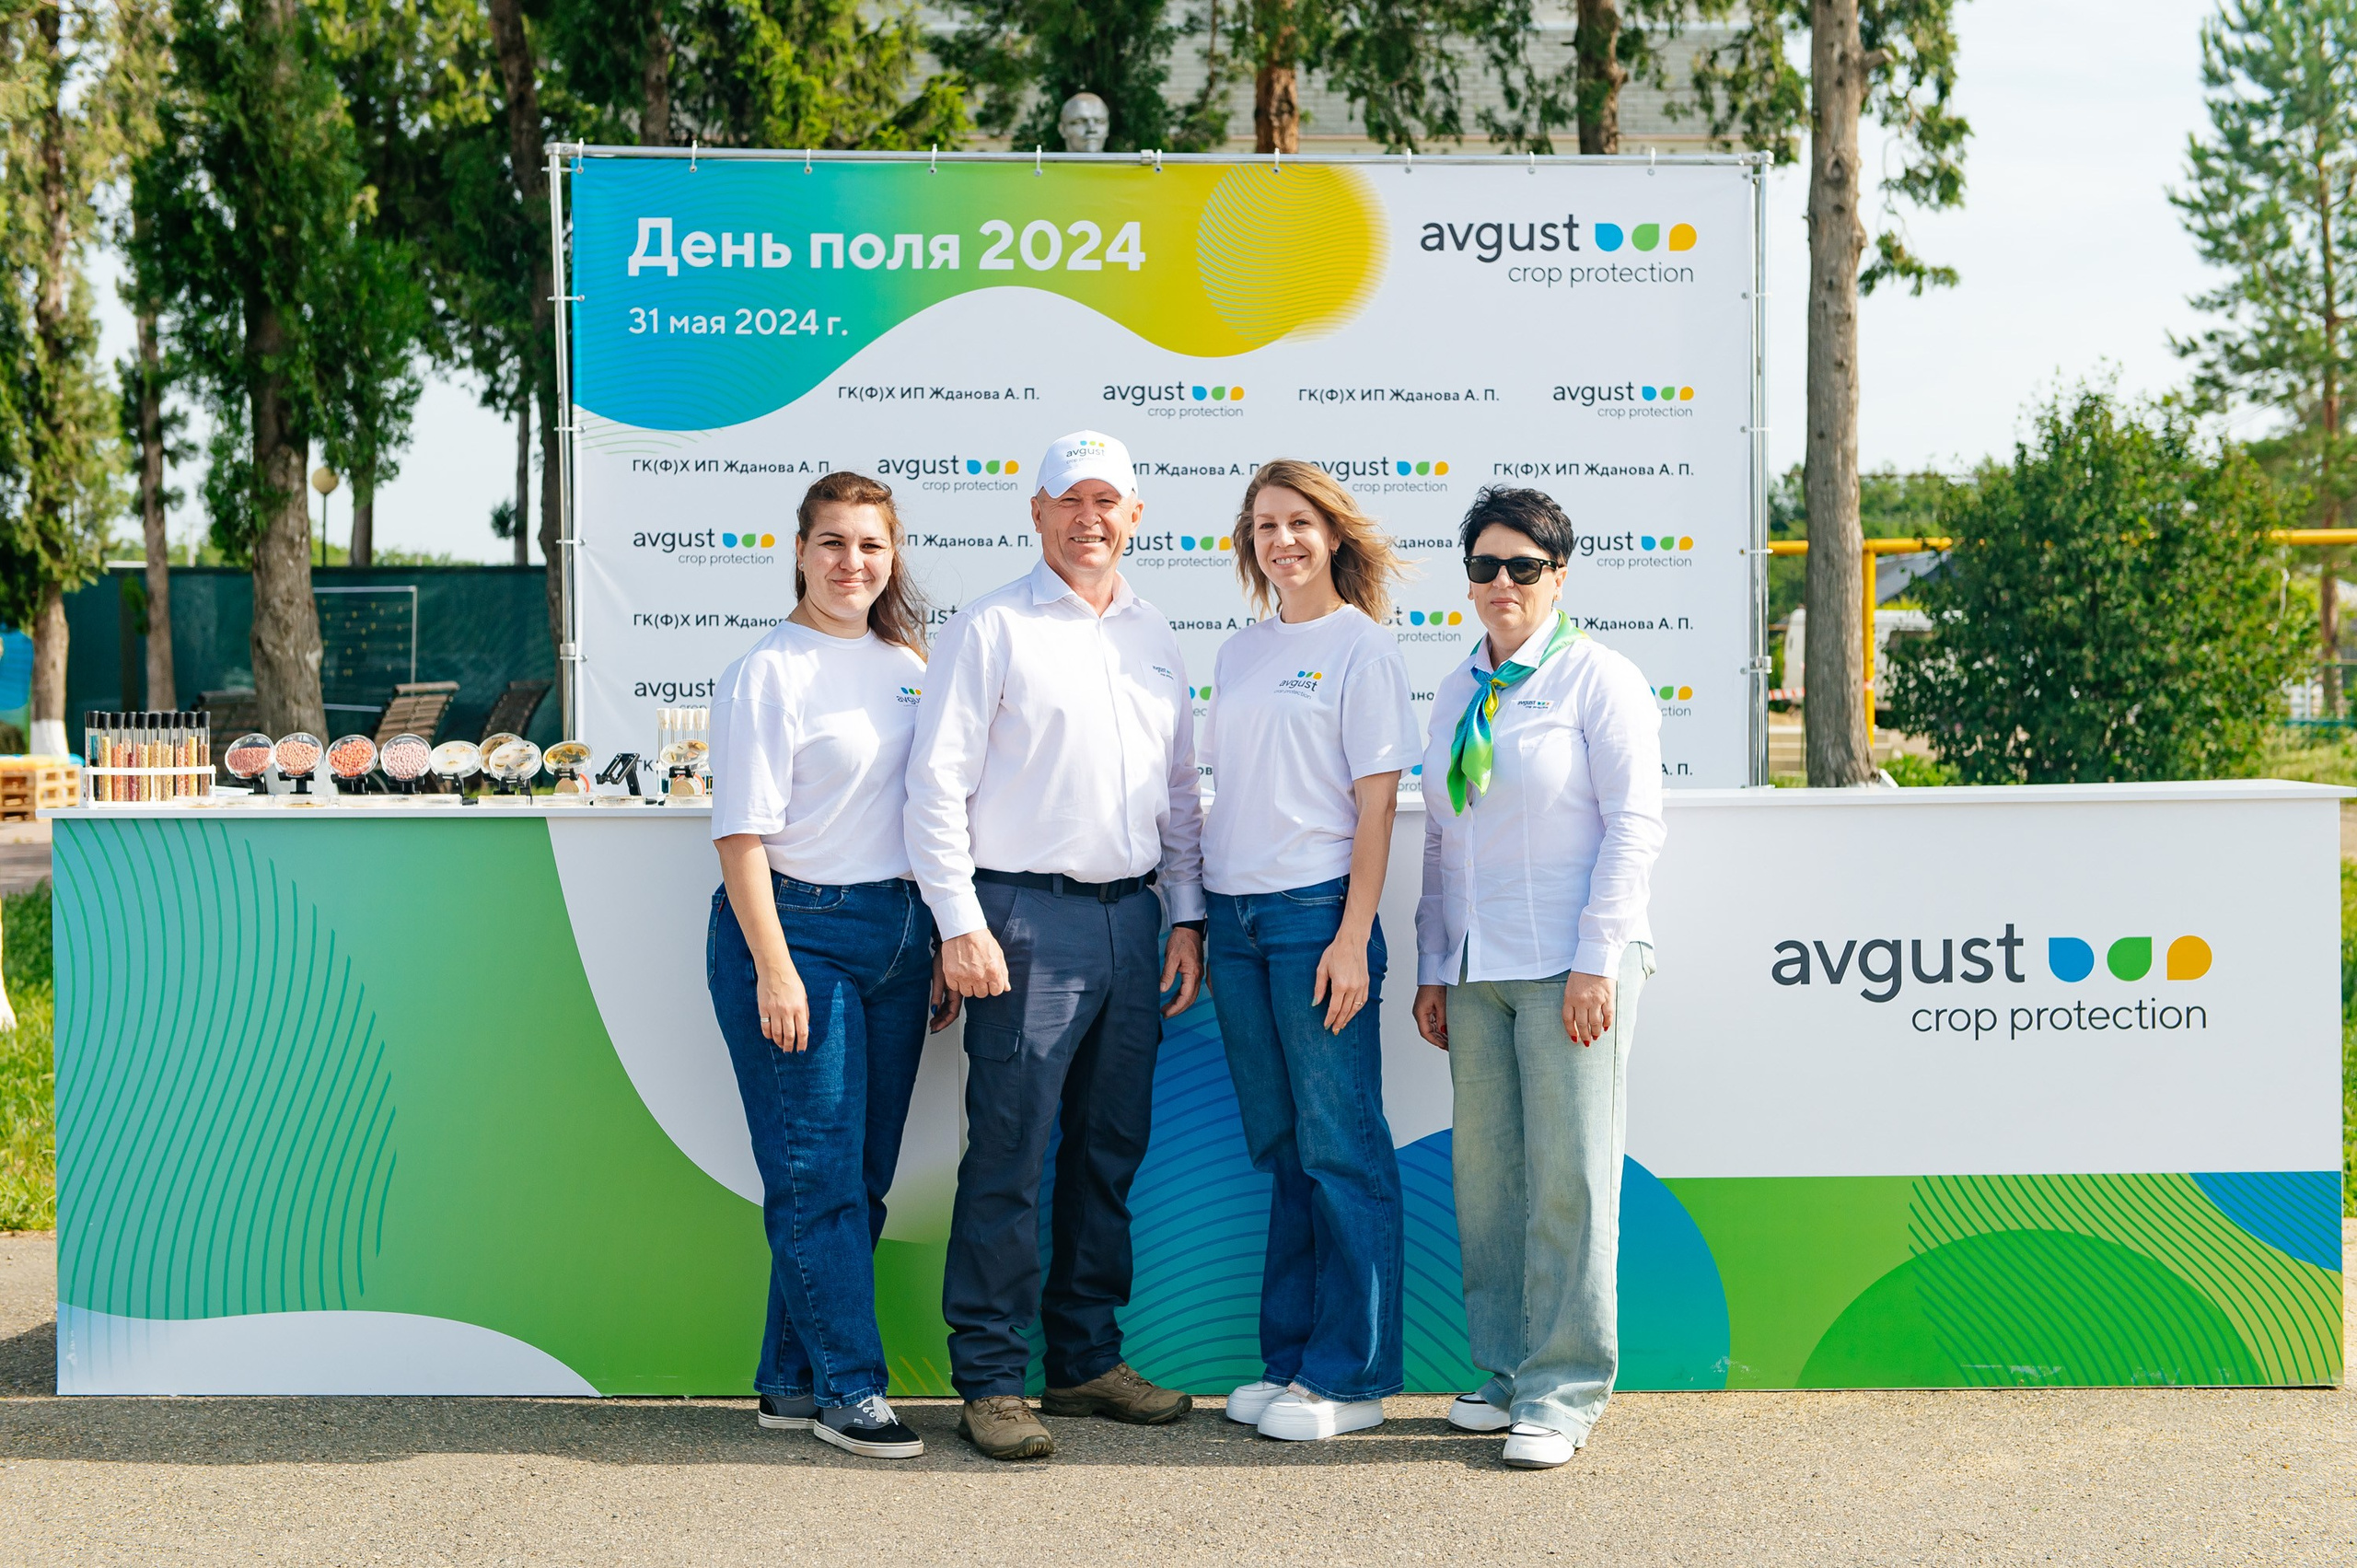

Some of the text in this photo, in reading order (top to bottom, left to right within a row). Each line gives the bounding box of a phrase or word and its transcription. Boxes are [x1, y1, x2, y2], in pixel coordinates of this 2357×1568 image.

[1421, 215, 1579, 262] avgust
[629, 218, 1145, 275] День поля 2024
[1509, 262, 1693, 287] crop protection
[630, 308, 847, 334] 31 мая 2024 г.
[839, 387, 1039, 401] ГК(Ф)Х ИП Жданова А. П.
[1104, 381, 1184, 406] avgust
[1299, 389, 1499, 403] ГК(Ф)Х ИП Жданова А. П.
[1553, 382, 1634, 406] avgust
[1148, 406, 1243, 419] crop protection
[1597, 406, 1692, 419] crop protection
[1066, 448, 1105, 458] avgust
[633, 459, 689, 474] ГК(Ф)Х
[695, 460, 718, 471] ИП
[724, 460, 794, 473] Жданова
[799, 461, 813, 472] А.
[877, 456, 959, 480] avgust
[1155, 463, 1225, 476] Жданова
[1230, 464, 1244, 475] А.
[1249, 463, 1260, 475] П
[1494, 463, 1693, 478] ГК(Ф)Х ИП Жданова А. П.
[923, 481, 1017, 493] crop protection
[1353, 482, 1447, 494] crop protection
[633, 528, 714, 552] avgust
[923, 535, 993, 548] Жданова
[998, 536, 1012, 546] А.
[1018, 535, 1032, 546] П.
[1122, 531, 1174, 556] gust
[1573, 531, 1634, 557] gust
[679, 553, 773, 567] crop protection
[1136, 555, 1232, 569] crop protection
[1597, 557, 1691, 569] crop protection
[634, 614, 784, 629] ГК(Ф)Х ИП Ждано
[1169, 620, 1222, 632] данова
[1226, 618, 1242, 630] А.
[1585, 618, 1653, 631] Жданова
[1659, 618, 1672, 629] А.
[1678, 618, 1692, 629] П.
[1397, 631, 1461, 645] protection
[634, 679, 715, 703] avgust
[1279, 679, 1318, 692] avgust
[1678, 763, 1693, 775] П.
[1772, 923, 2025, 1003] avgust
[1912, 998, 2206, 1040] crop protection
